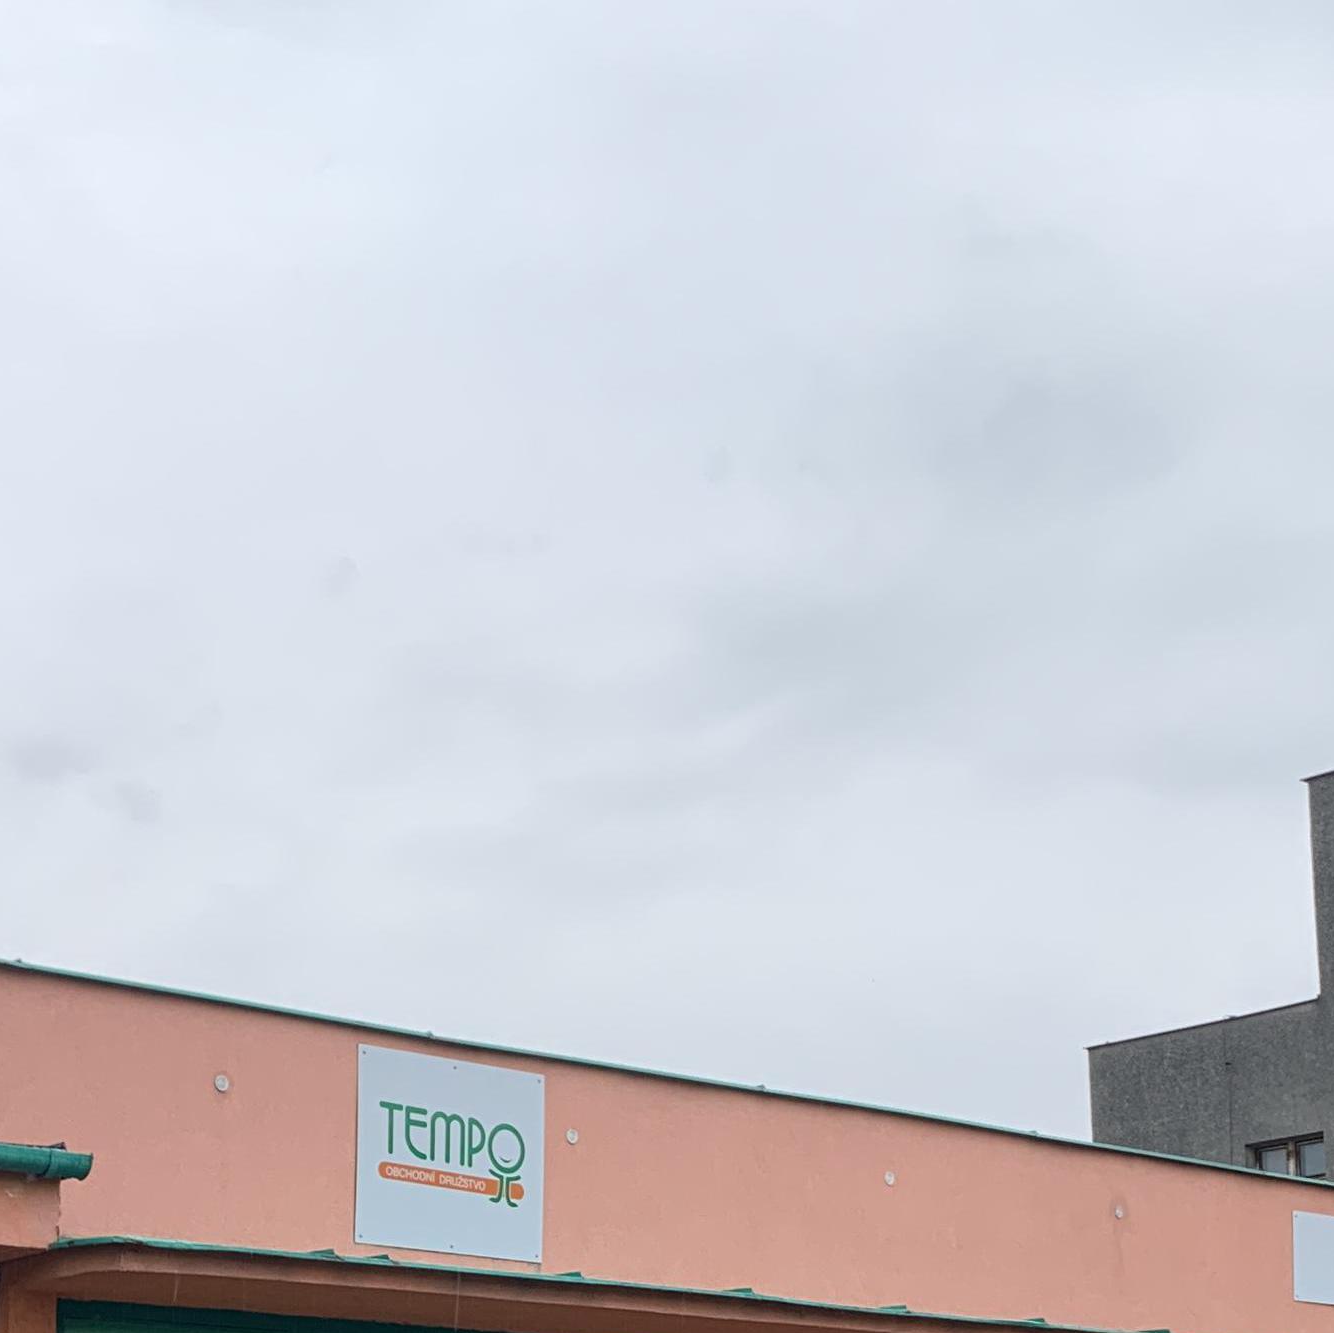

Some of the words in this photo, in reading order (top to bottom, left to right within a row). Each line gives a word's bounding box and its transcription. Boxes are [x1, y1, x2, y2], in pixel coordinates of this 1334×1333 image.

[379, 1100, 525, 1175] TEMPO
[385, 1166, 435, 1183] OBCHODNÍ
[439, 1174, 486, 1192] DRUŽSTVO
